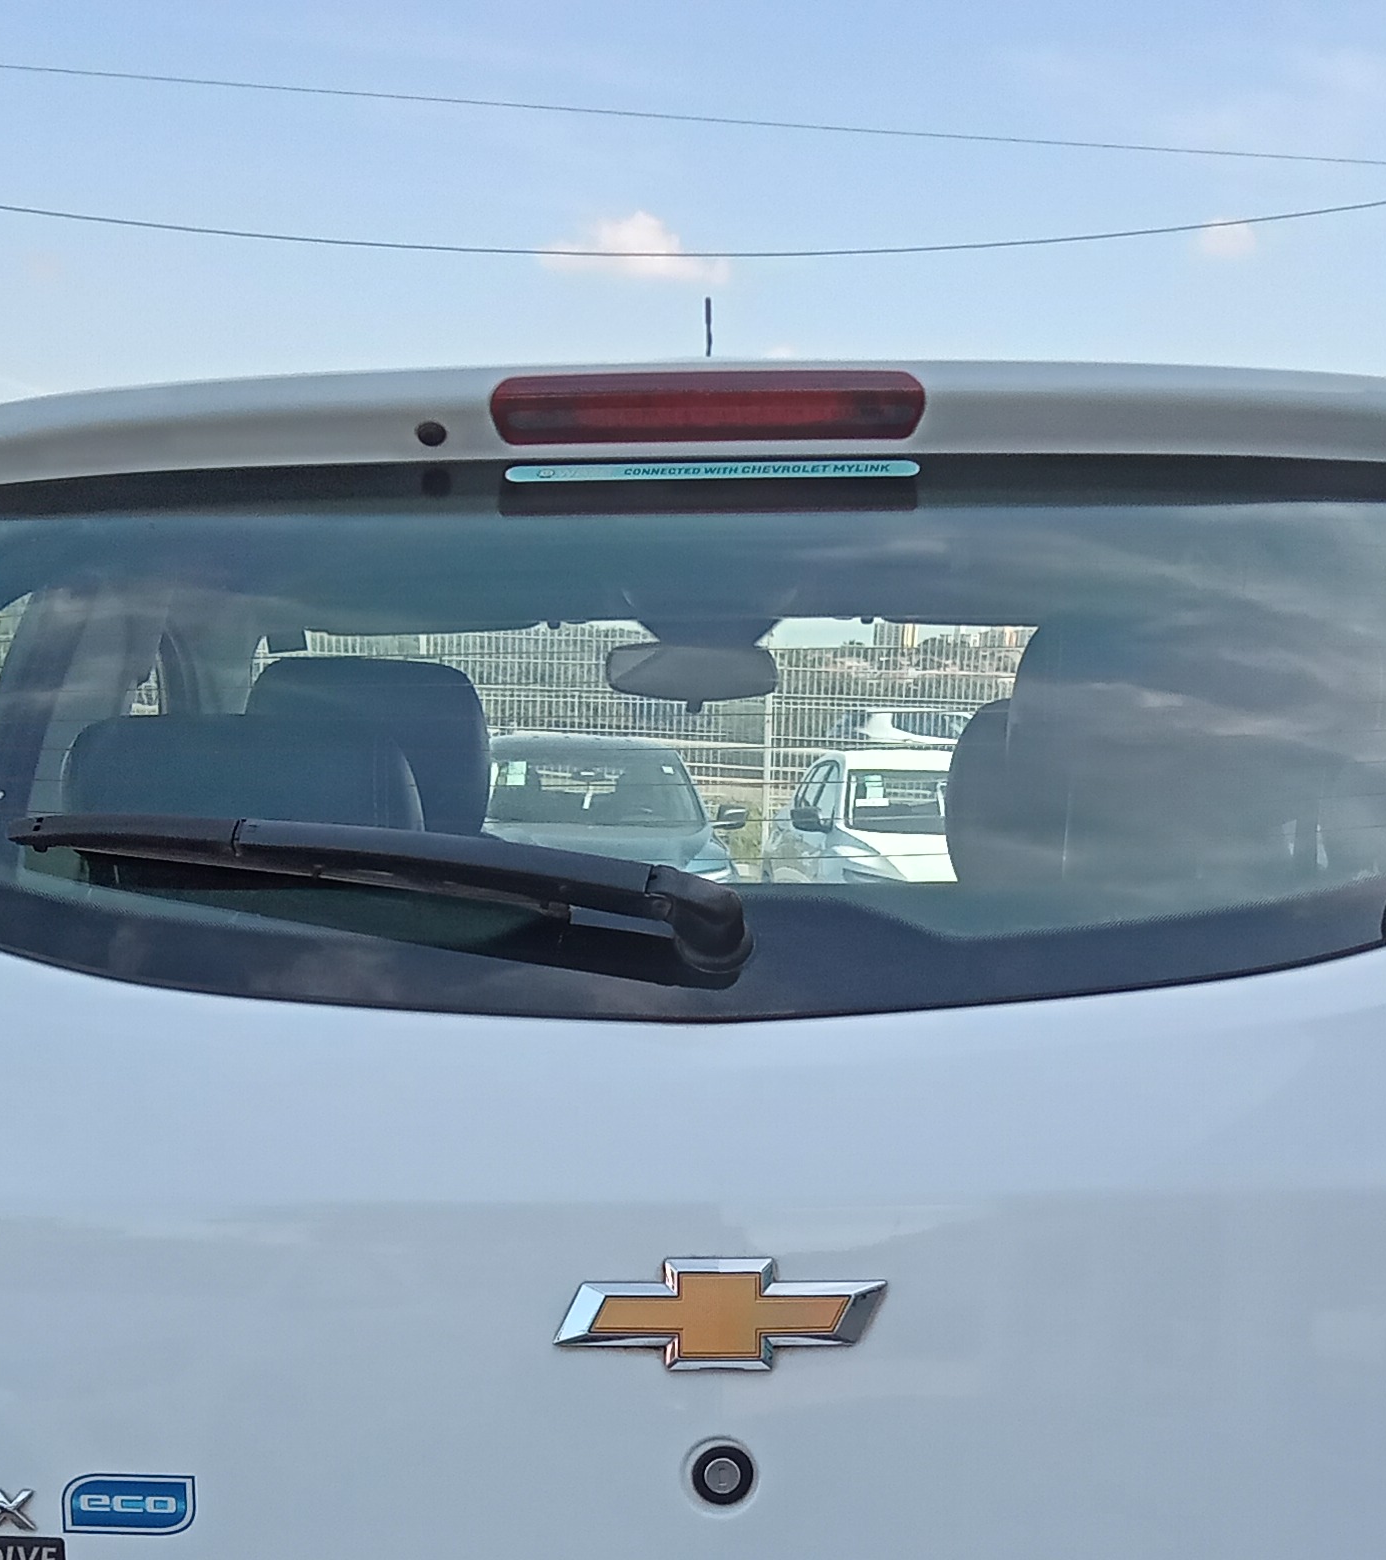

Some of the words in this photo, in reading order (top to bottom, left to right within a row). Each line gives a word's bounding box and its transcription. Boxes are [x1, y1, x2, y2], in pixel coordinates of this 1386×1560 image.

[623, 466, 702, 477] CONNECTED
[703, 466, 738, 475] WITH
[741, 464, 830, 475] CHEVROLET
[832, 463, 891, 473] MYLINK
[79, 1494, 177, 1514] eco
